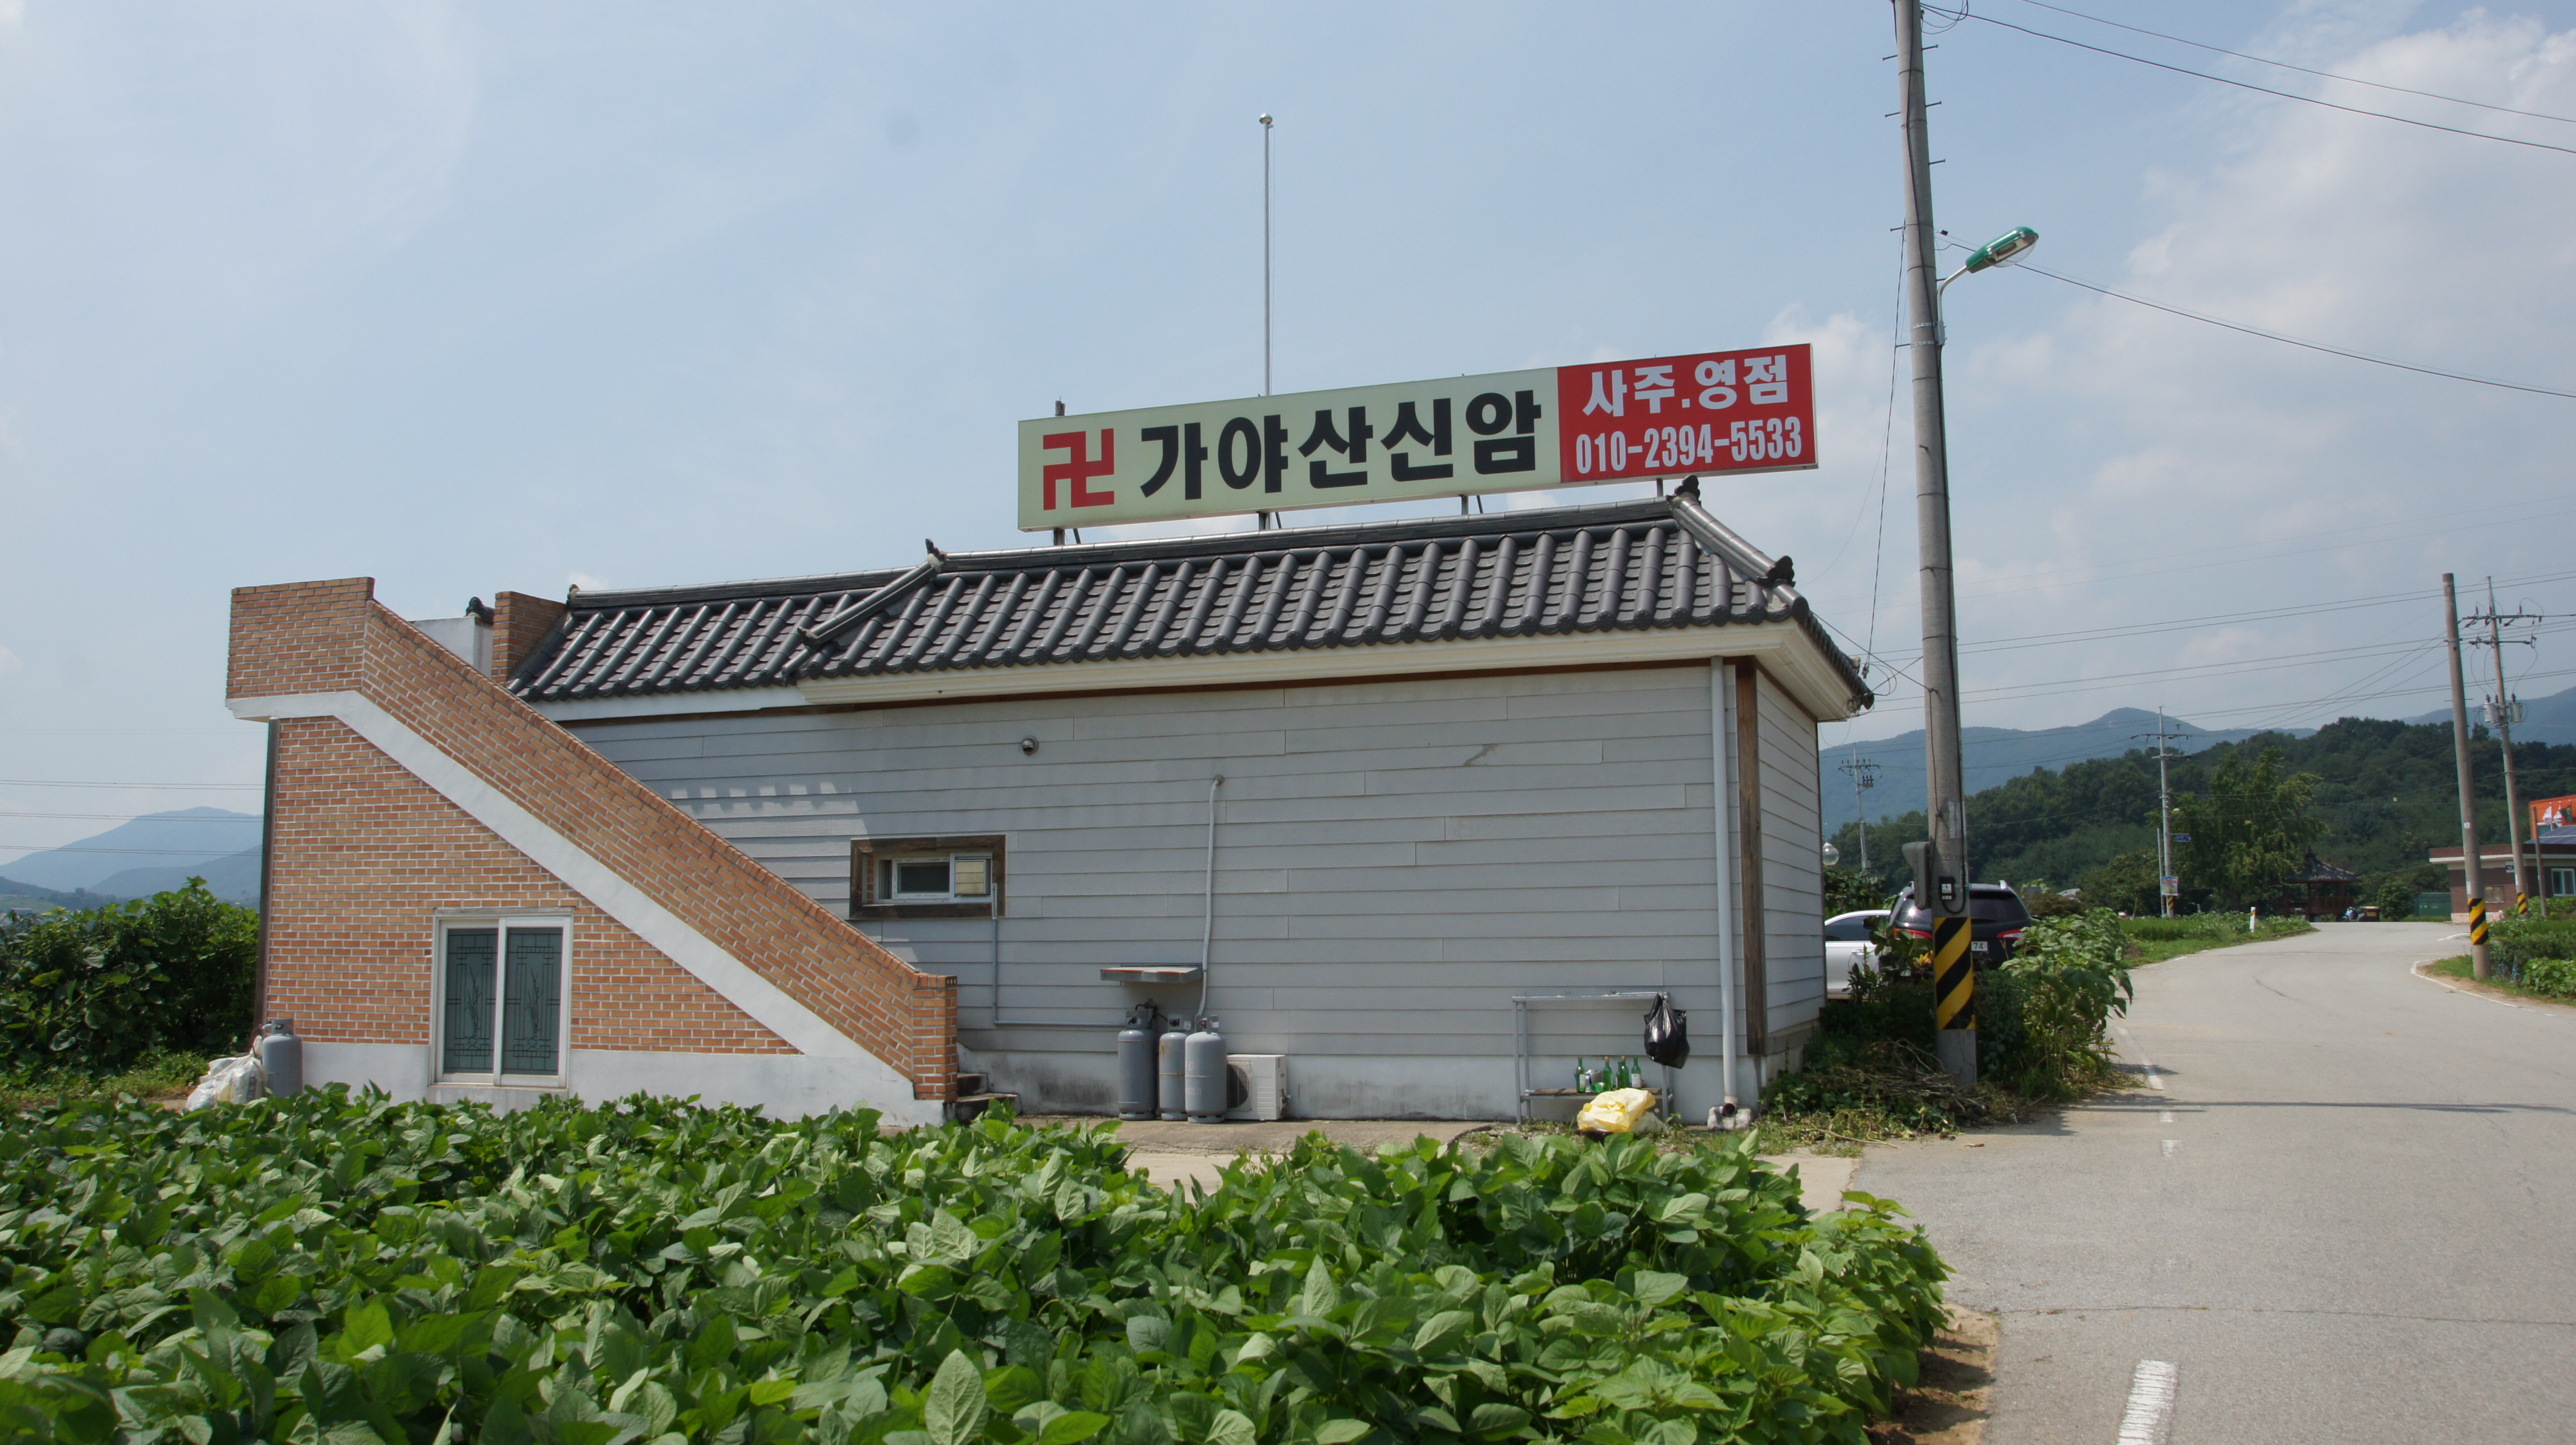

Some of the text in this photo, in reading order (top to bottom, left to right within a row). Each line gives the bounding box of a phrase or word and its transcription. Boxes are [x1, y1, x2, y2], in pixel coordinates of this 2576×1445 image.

[1582, 355, 1788, 417] 사주.영점
[1139, 389, 1543, 501] 가야산신암
[1575, 416, 1802, 474] 010-2394-5533
